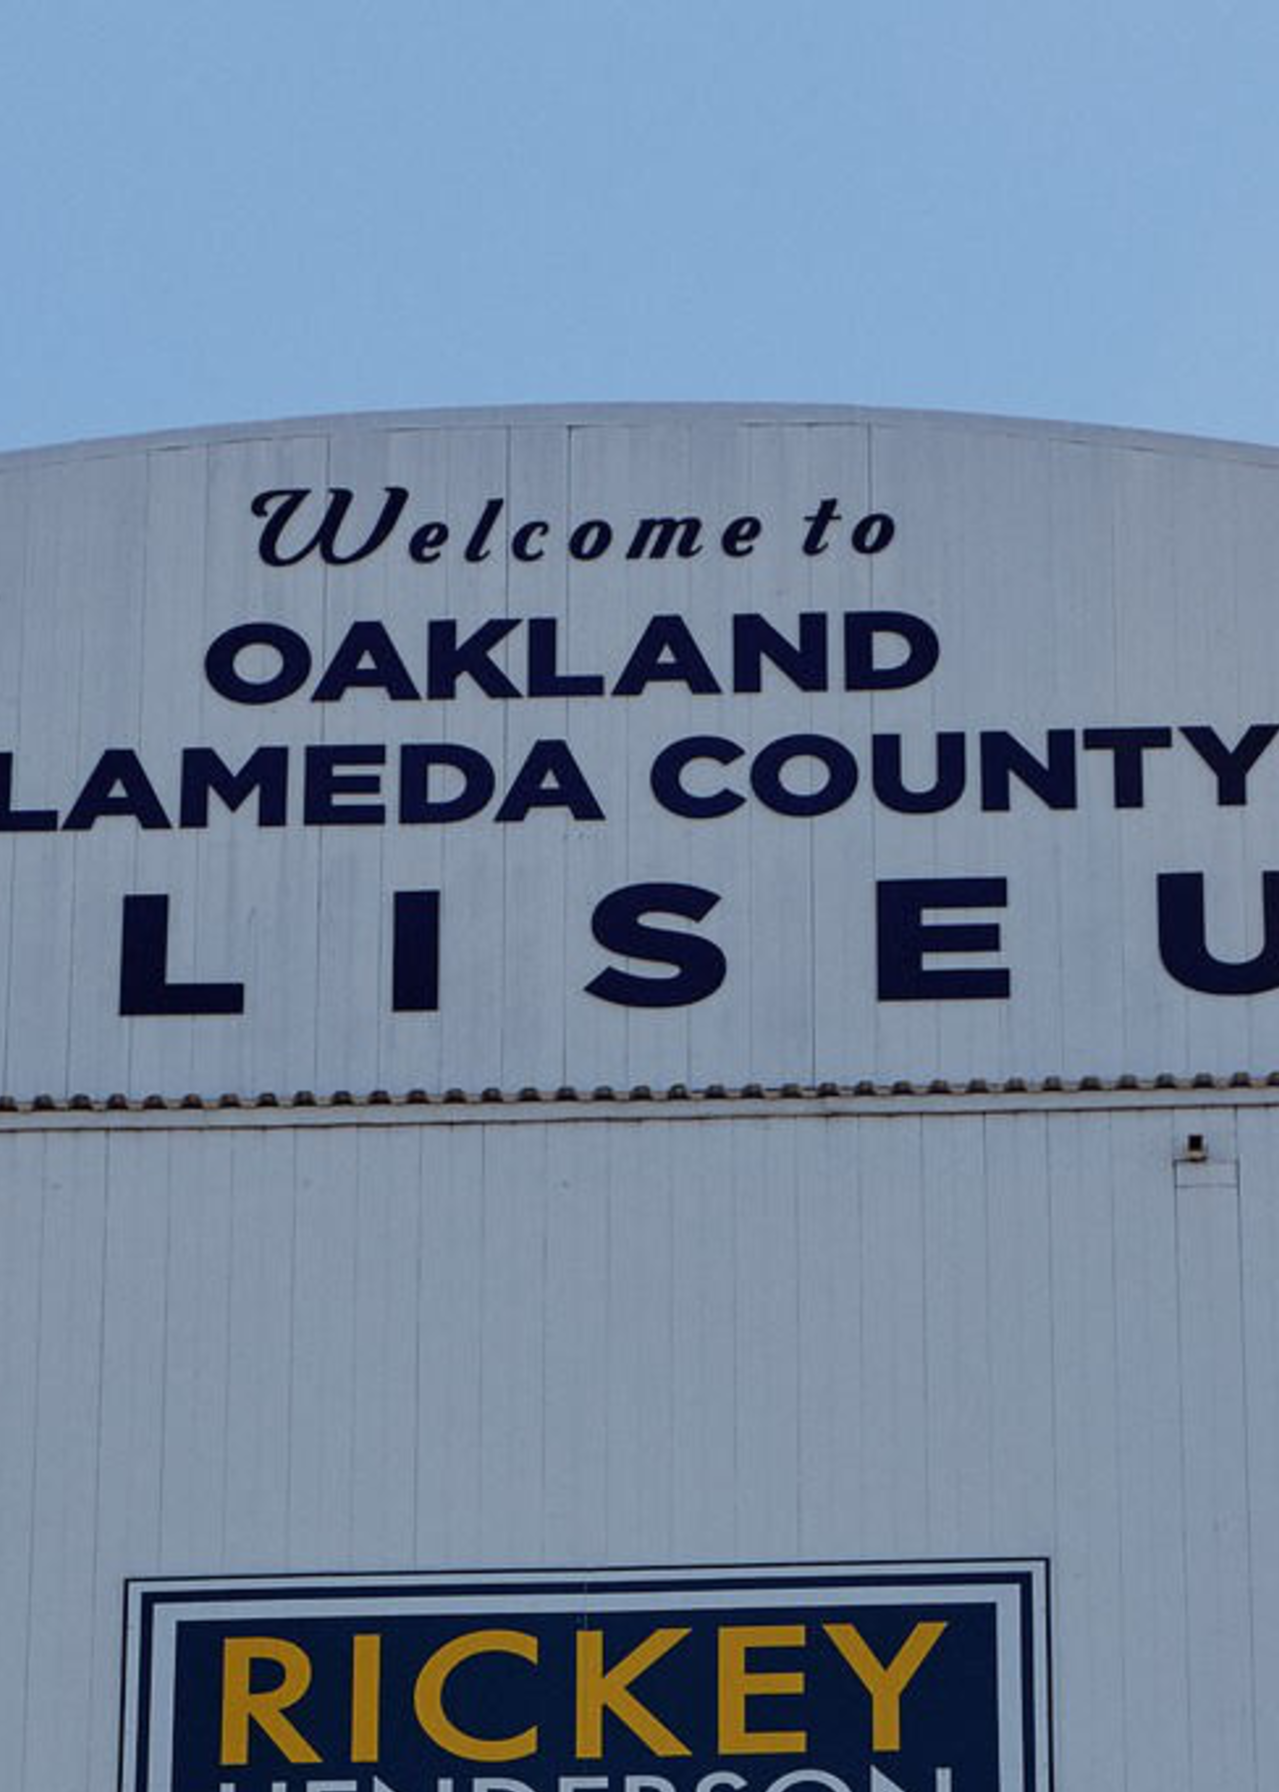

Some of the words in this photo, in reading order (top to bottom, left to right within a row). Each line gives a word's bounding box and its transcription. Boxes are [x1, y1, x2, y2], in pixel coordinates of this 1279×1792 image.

[250, 486, 762, 569] Welcome
[802, 497, 895, 557] to
[203, 610, 940, 706] OAKLAND
[221, 1622, 949, 1766] RICKEY
